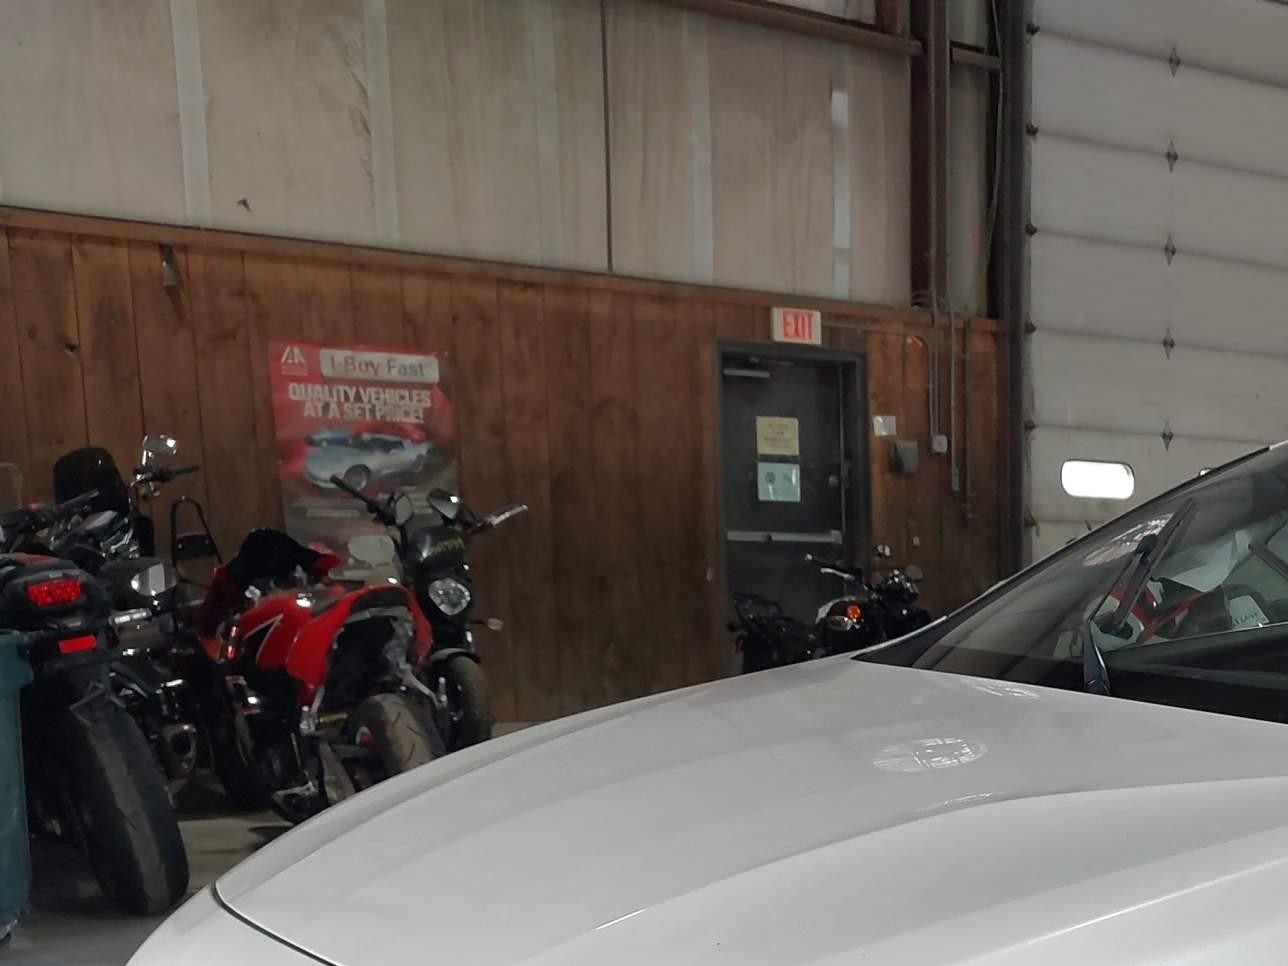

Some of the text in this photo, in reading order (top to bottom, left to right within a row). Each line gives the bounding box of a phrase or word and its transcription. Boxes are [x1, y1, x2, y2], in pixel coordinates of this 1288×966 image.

[783, 310, 813, 340] EXIT
[387, 358, 424, 377] Fast
[288, 382, 432, 408] QUALITY VEHICLES
[303, 401, 424, 424] AT A SET PRICE!
